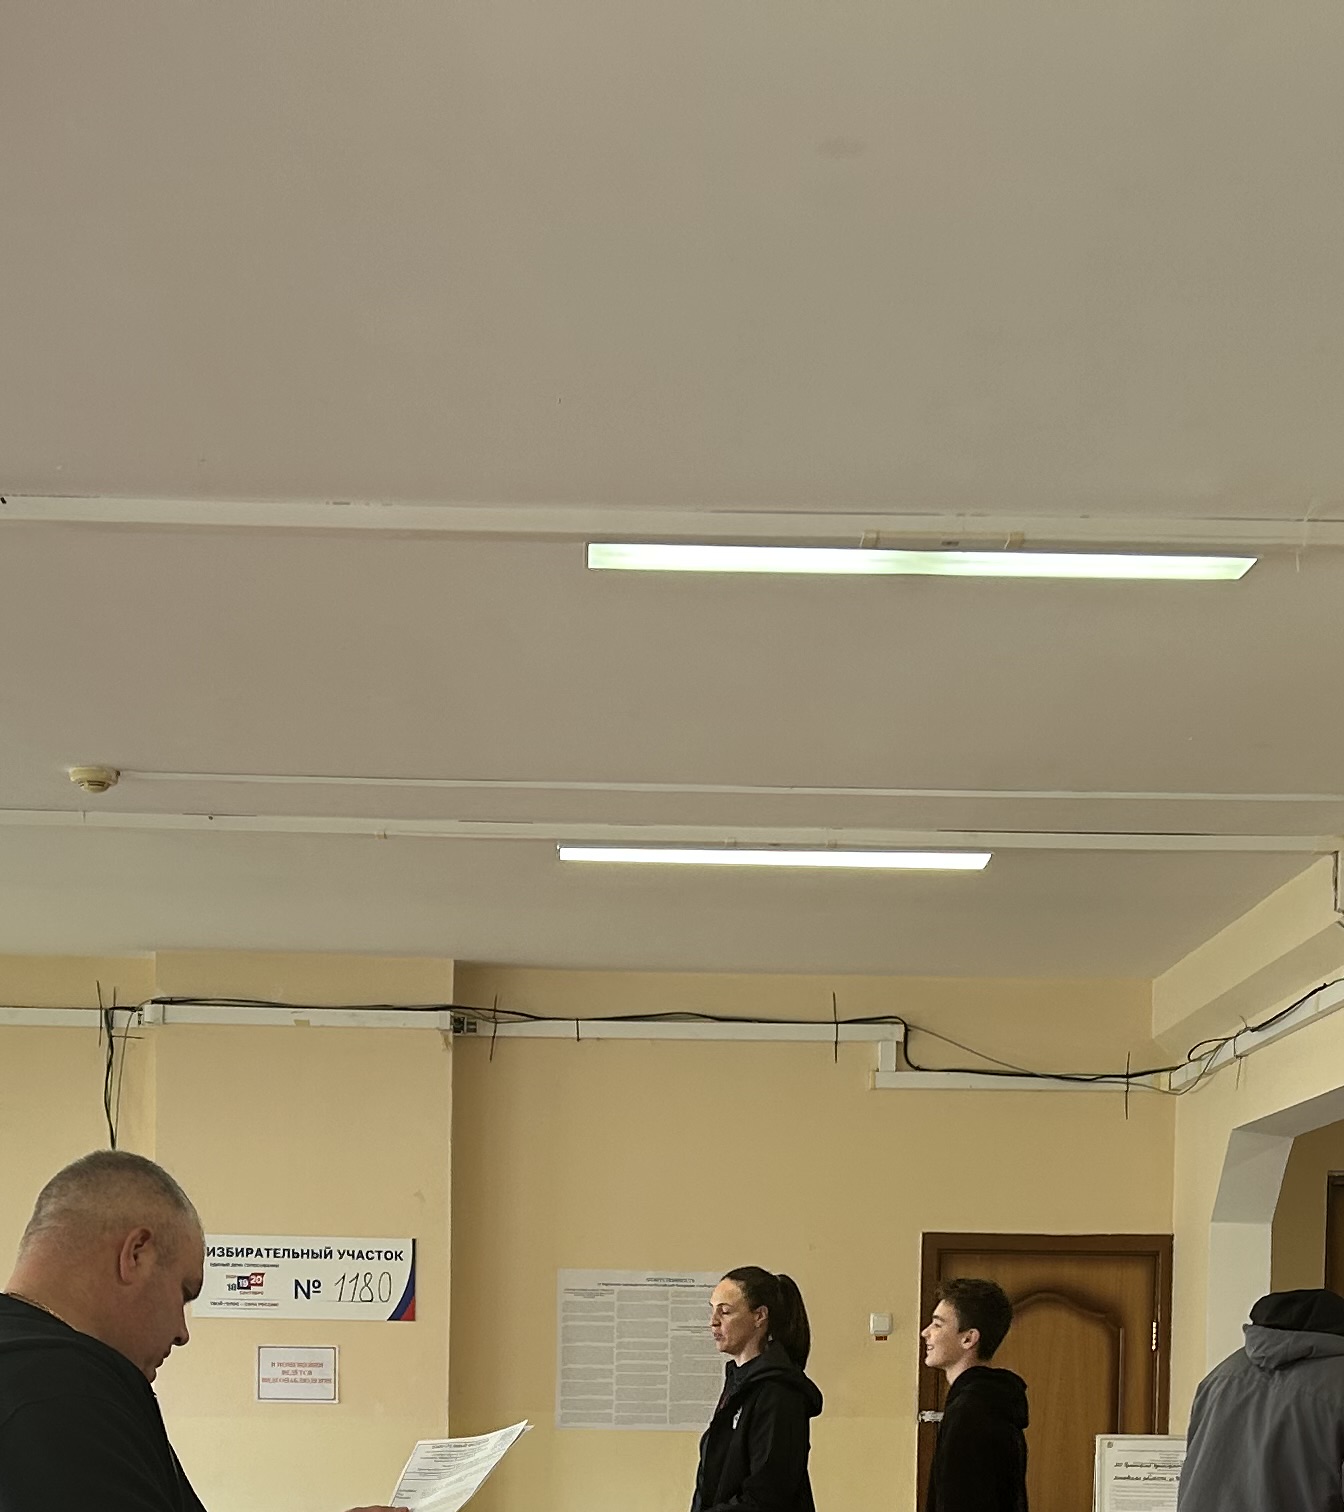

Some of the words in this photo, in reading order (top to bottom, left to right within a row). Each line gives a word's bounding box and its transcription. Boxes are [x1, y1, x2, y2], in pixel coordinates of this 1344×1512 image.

[206, 1246, 333, 1260] ИЗБИРАТЕЛЬНЫЙ
[337, 1249, 404, 1262] УЧАСТОК
[238, 1278, 249, 1288] 19
[250, 1275, 263, 1285] 20
[294, 1279, 322, 1300] №
[334, 1271, 393, 1303] 1180
